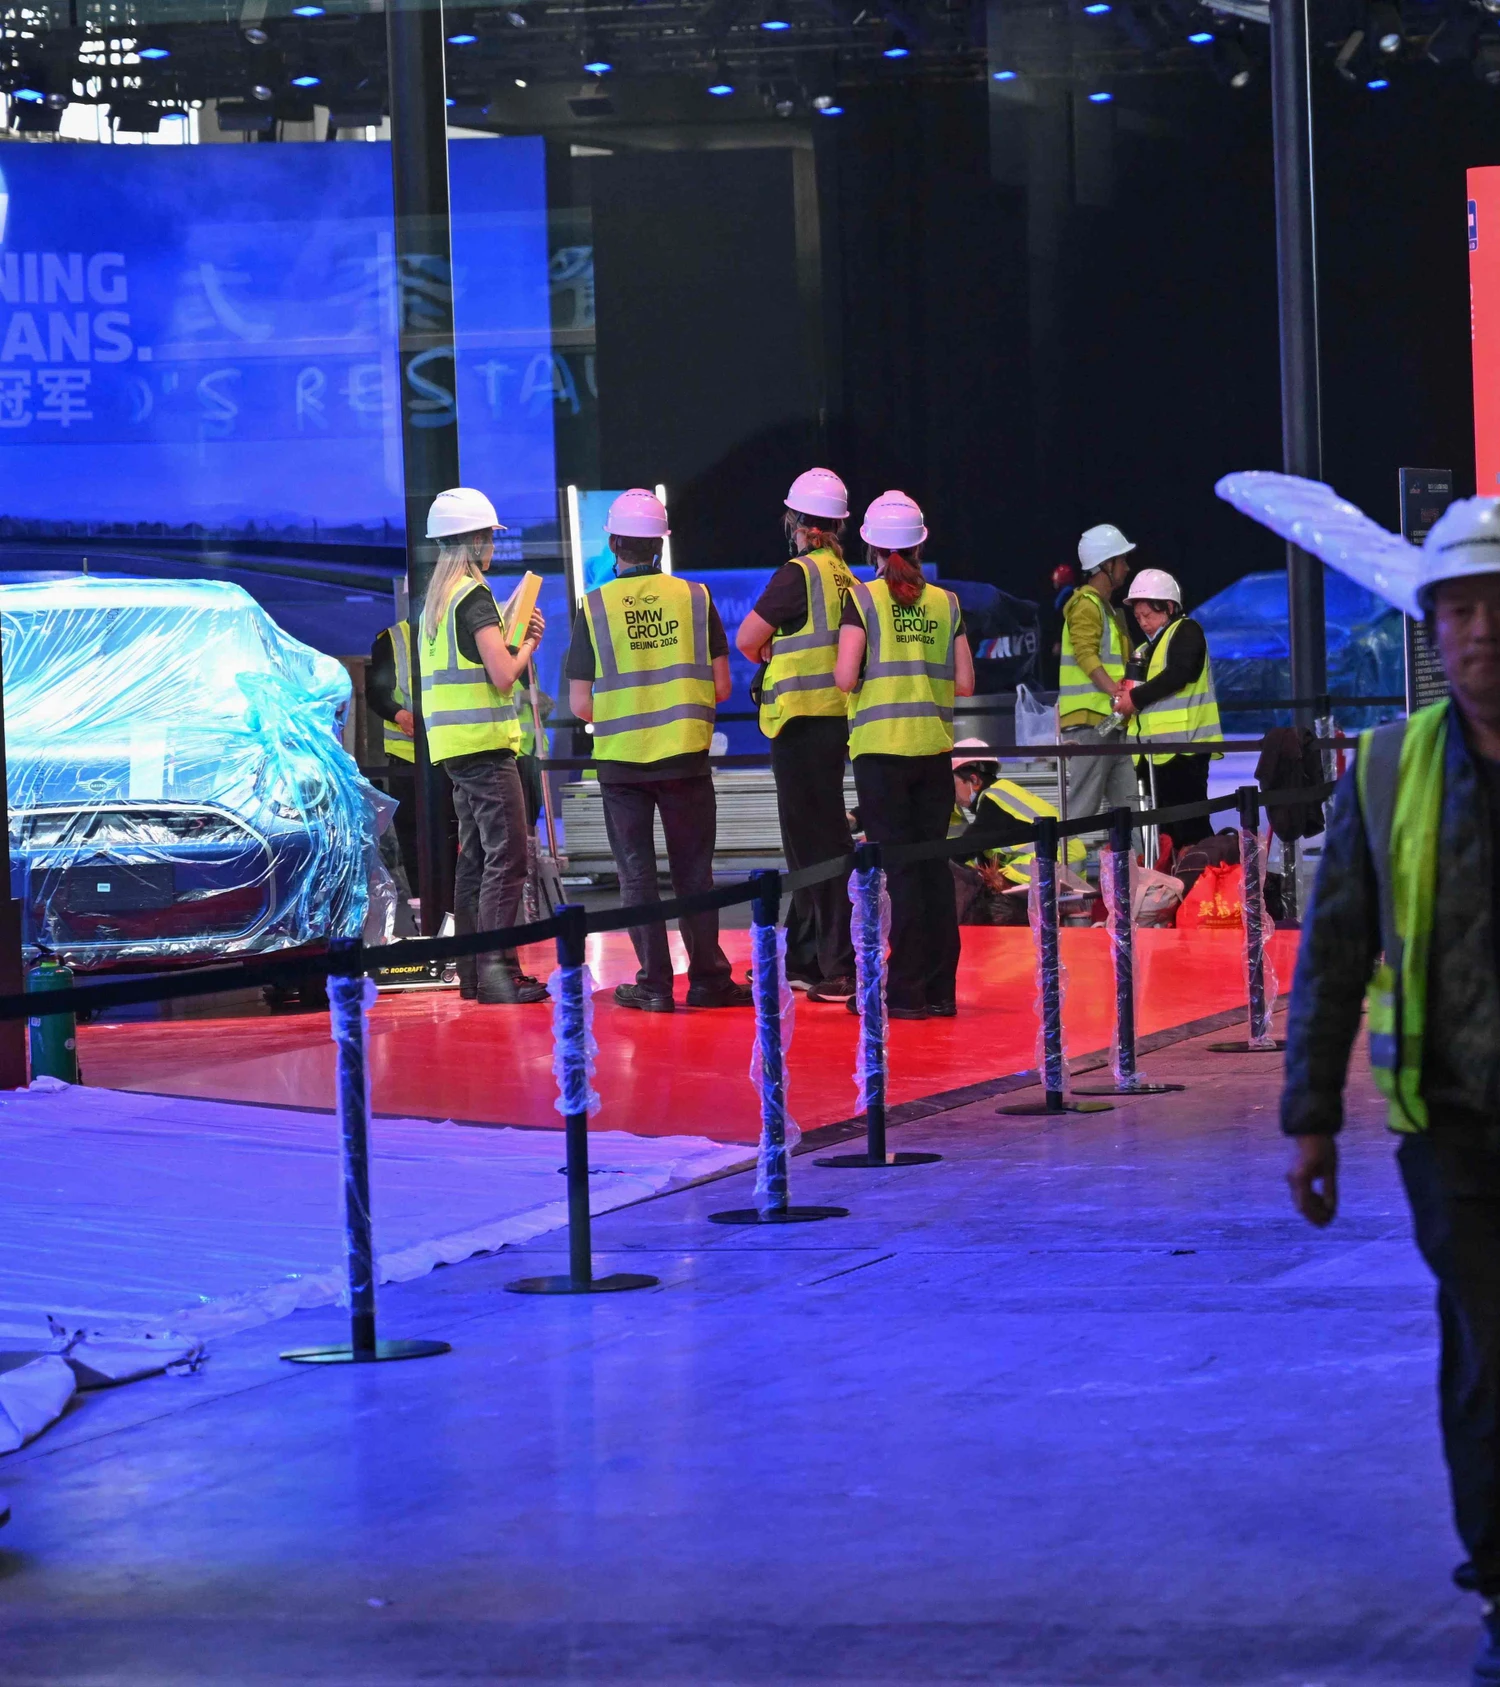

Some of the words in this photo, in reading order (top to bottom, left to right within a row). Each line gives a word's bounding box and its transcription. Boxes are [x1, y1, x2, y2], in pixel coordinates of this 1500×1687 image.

[1, 311, 152, 363] ANS.
[295, 346, 598, 432] RESTA
[624, 607, 663, 625] BMW
[891, 604, 926, 618] BMW
[627, 620, 679, 640] GROUP
[630, 639, 659, 651] BEIJING
[660, 636, 679, 648] 2026
[390, 965, 424, 974] RODCRAFT
